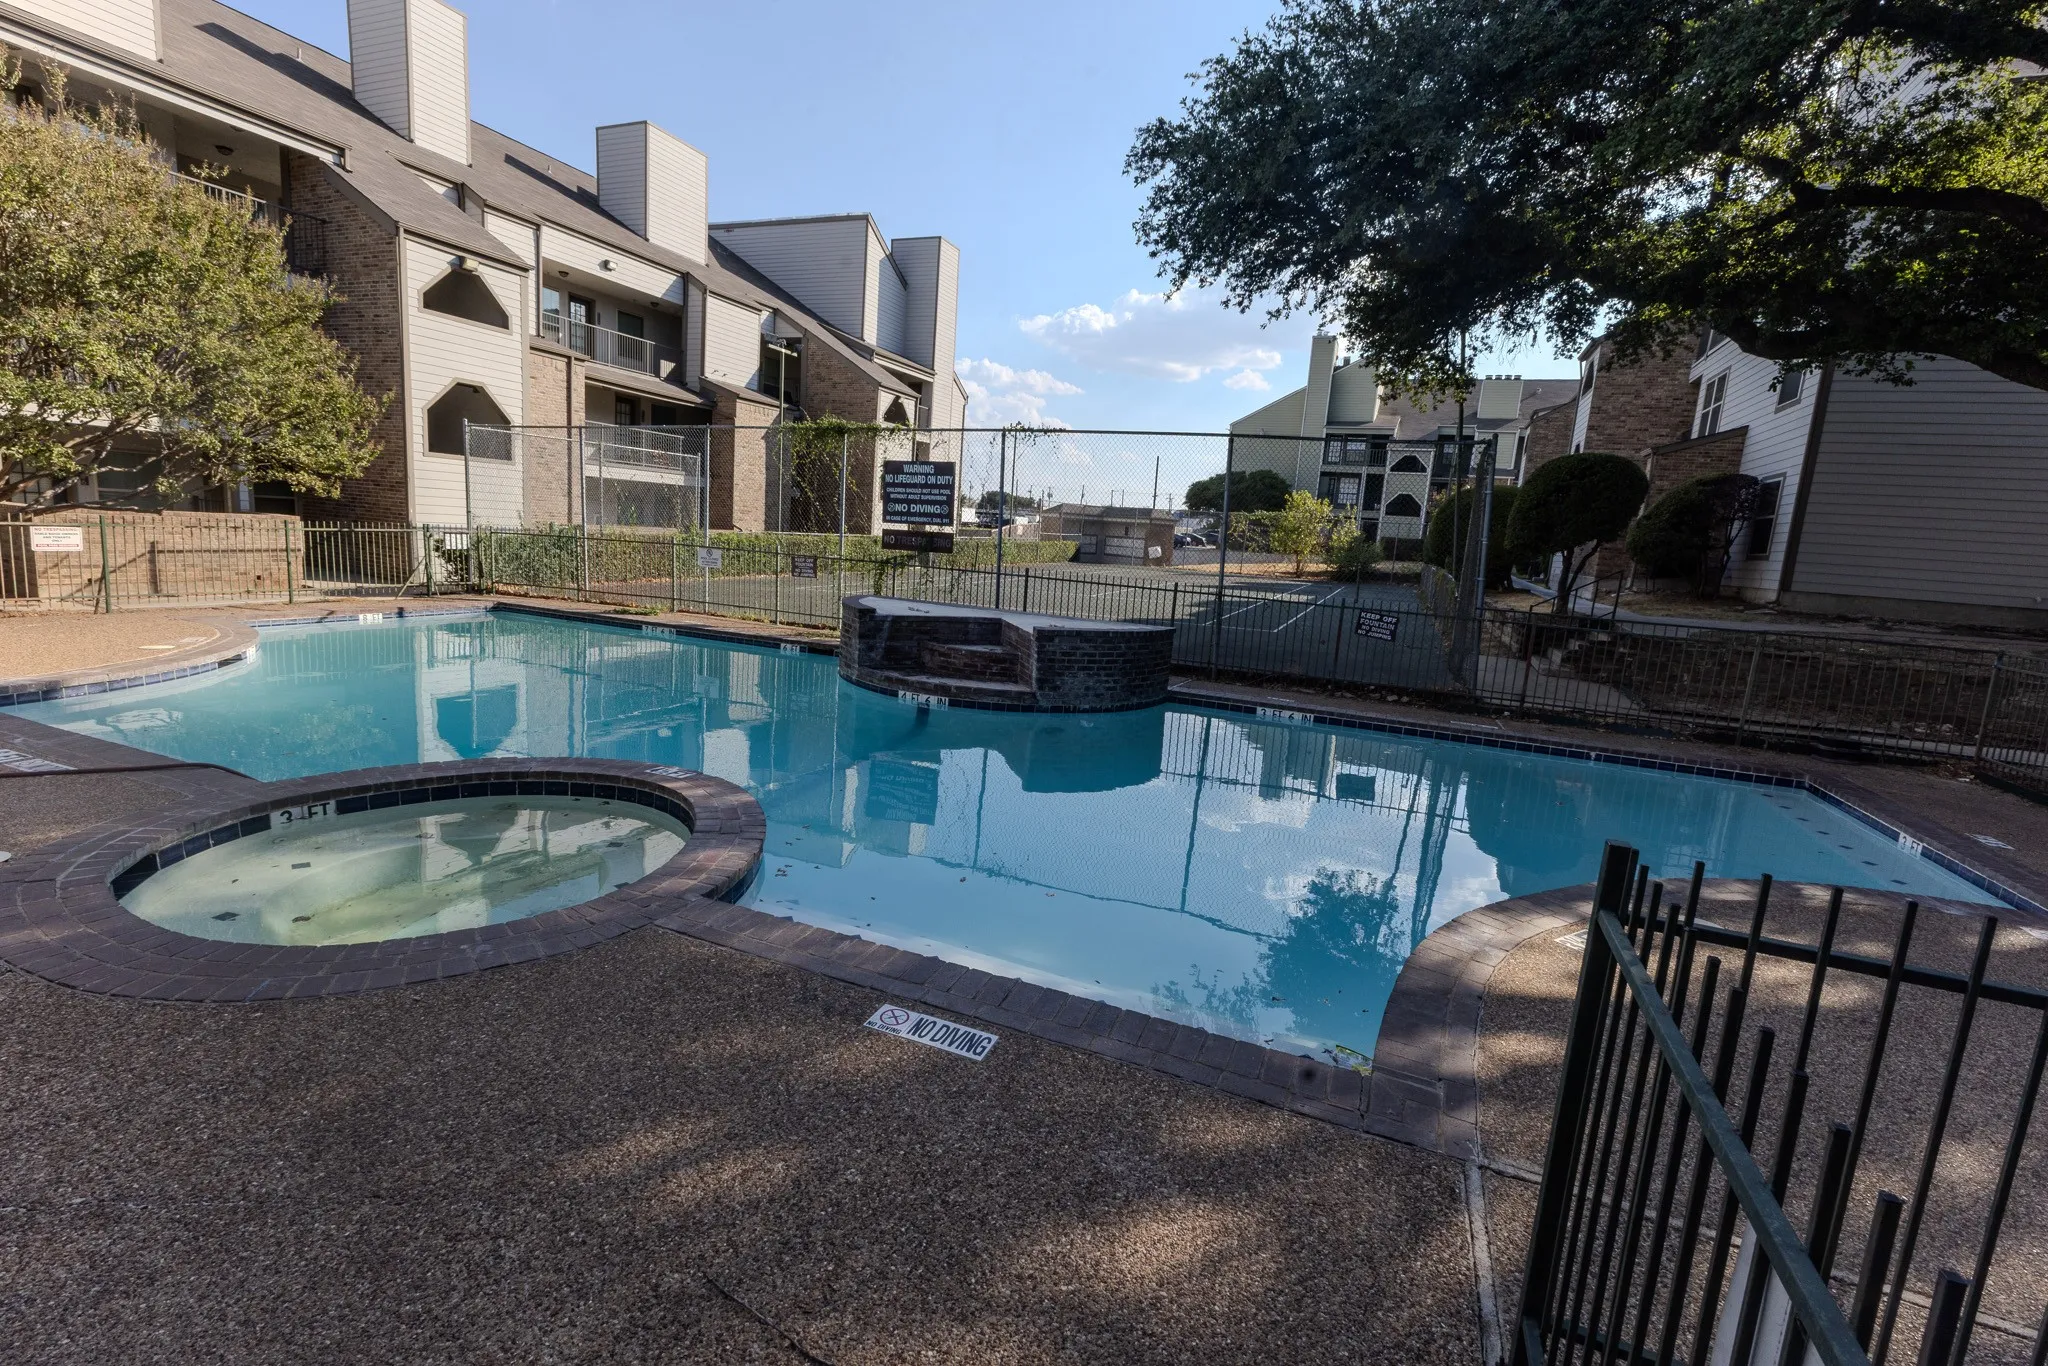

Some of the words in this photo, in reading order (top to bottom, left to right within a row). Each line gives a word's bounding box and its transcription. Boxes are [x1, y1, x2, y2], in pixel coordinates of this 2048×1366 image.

[903, 464, 935, 474] WARNING
[885, 474, 894, 483] NO
[894, 474, 926, 484] LIFEGUARD
[927, 475, 936, 484] ON
[937, 475, 953, 485] DUTY
[895, 504, 908, 512] NO
[910, 504, 940, 514] DIVING
[884, 535, 895, 544] NO
[896, 536, 951, 549] TRESPASING
[372, 614, 380, 622] FT
[1361, 611, 1380, 620] KEEP
[1382, 616, 1398, 624] OFF
[1360, 618, 1395, 630] FOUNTAIN
[1371, 626, 1390, 634] DIVING
[1368, 632, 1391, 640] JUMPING
[911, 693, 921, 701] FT
[1261, 708, 1267, 716] 3
[1272, 709, 1283, 717] FT
[1302, 714, 1311, 722] IN
[280, 810, 293, 825] 3
[307, 802, 330, 818] FT
[1902, 836, 1907, 850] 3
[1910, 841, 1920, 852] FT
[877, 1023, 902, 1035] DIVING
[906, 1017, 937, 1039] NO
[929, 1023, 992, 1056] DIVING
